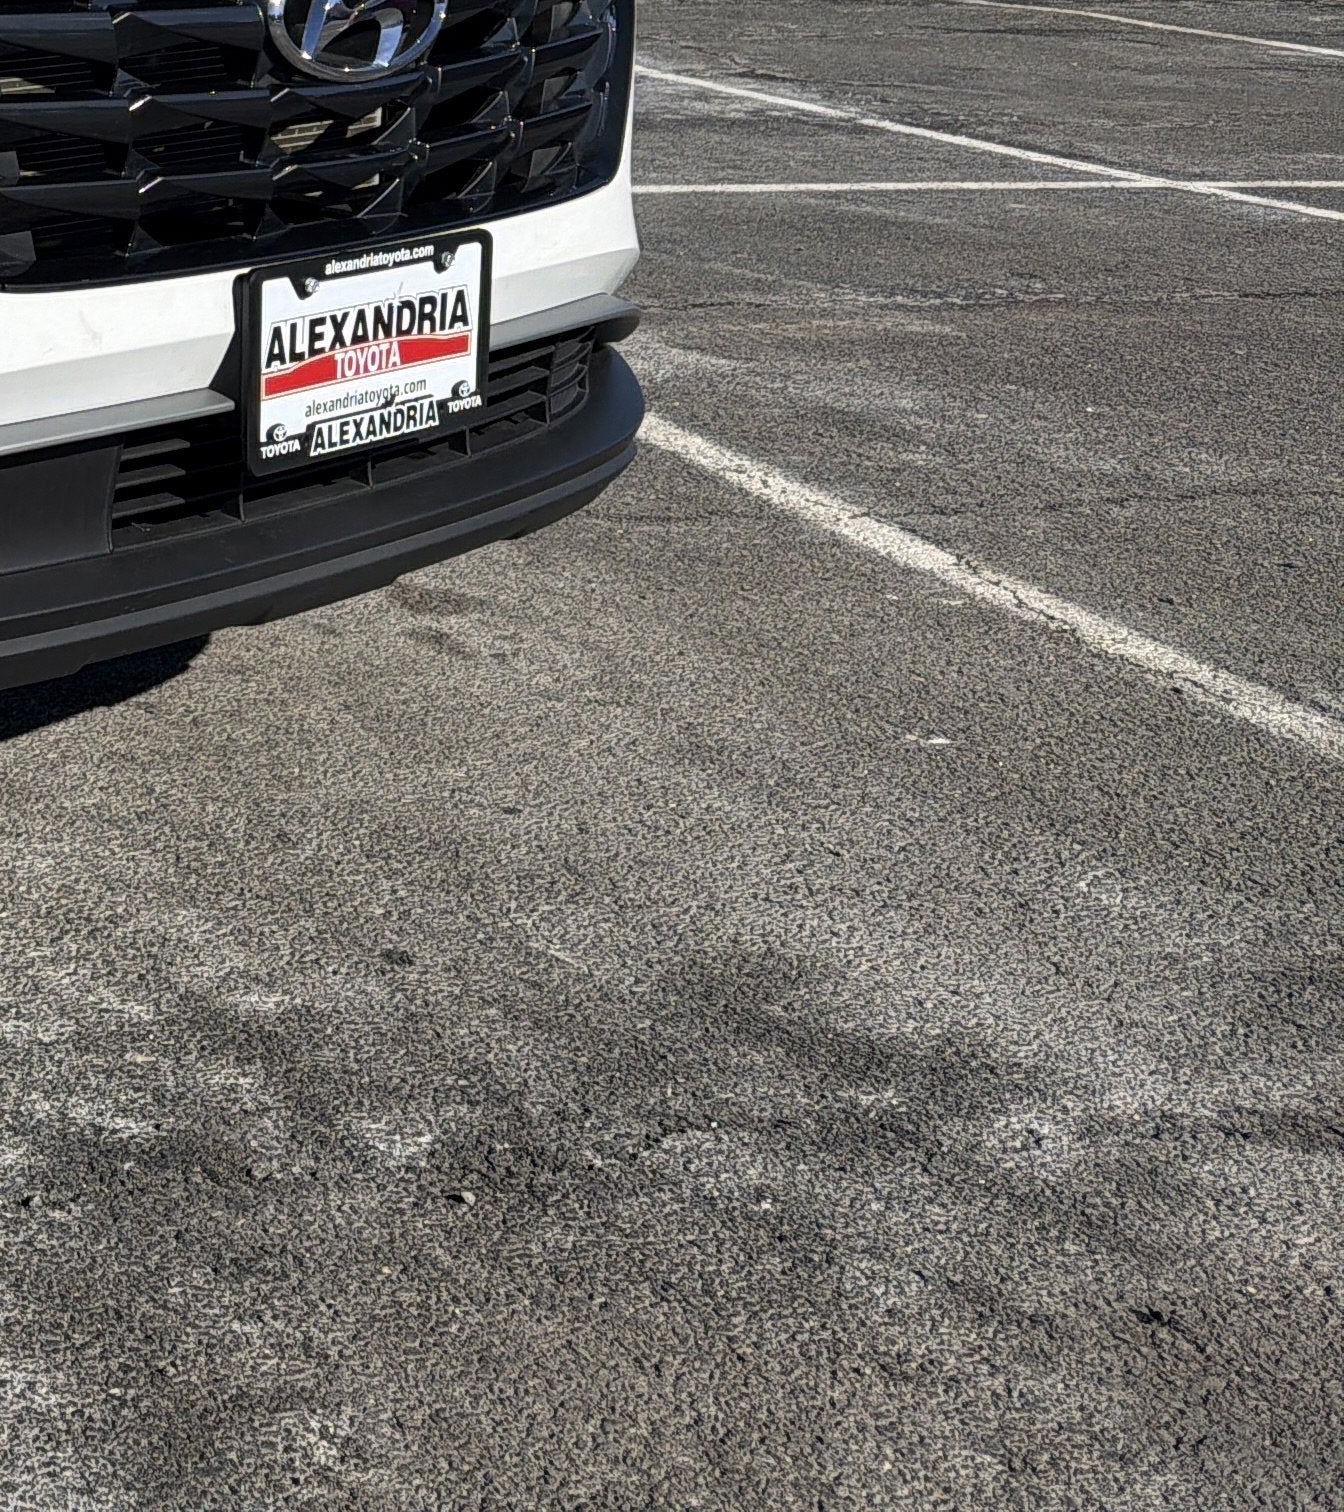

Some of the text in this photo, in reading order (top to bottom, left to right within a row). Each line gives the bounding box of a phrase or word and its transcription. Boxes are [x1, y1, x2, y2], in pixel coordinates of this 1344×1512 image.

[325, 245, 434, 275] alexandriatoyota.com
[265, 288, 469, 369] ALEXANDRIA
[334, 341, 401, 379] TOYOTA
[305, 377, 427, 418] alexandriatoyota.com
[447, 395, 482, 413] TOYOTA
[311, 400, 439, 455] ALEXANDRIA
[261, 439, 301, 459] TOYOTA
